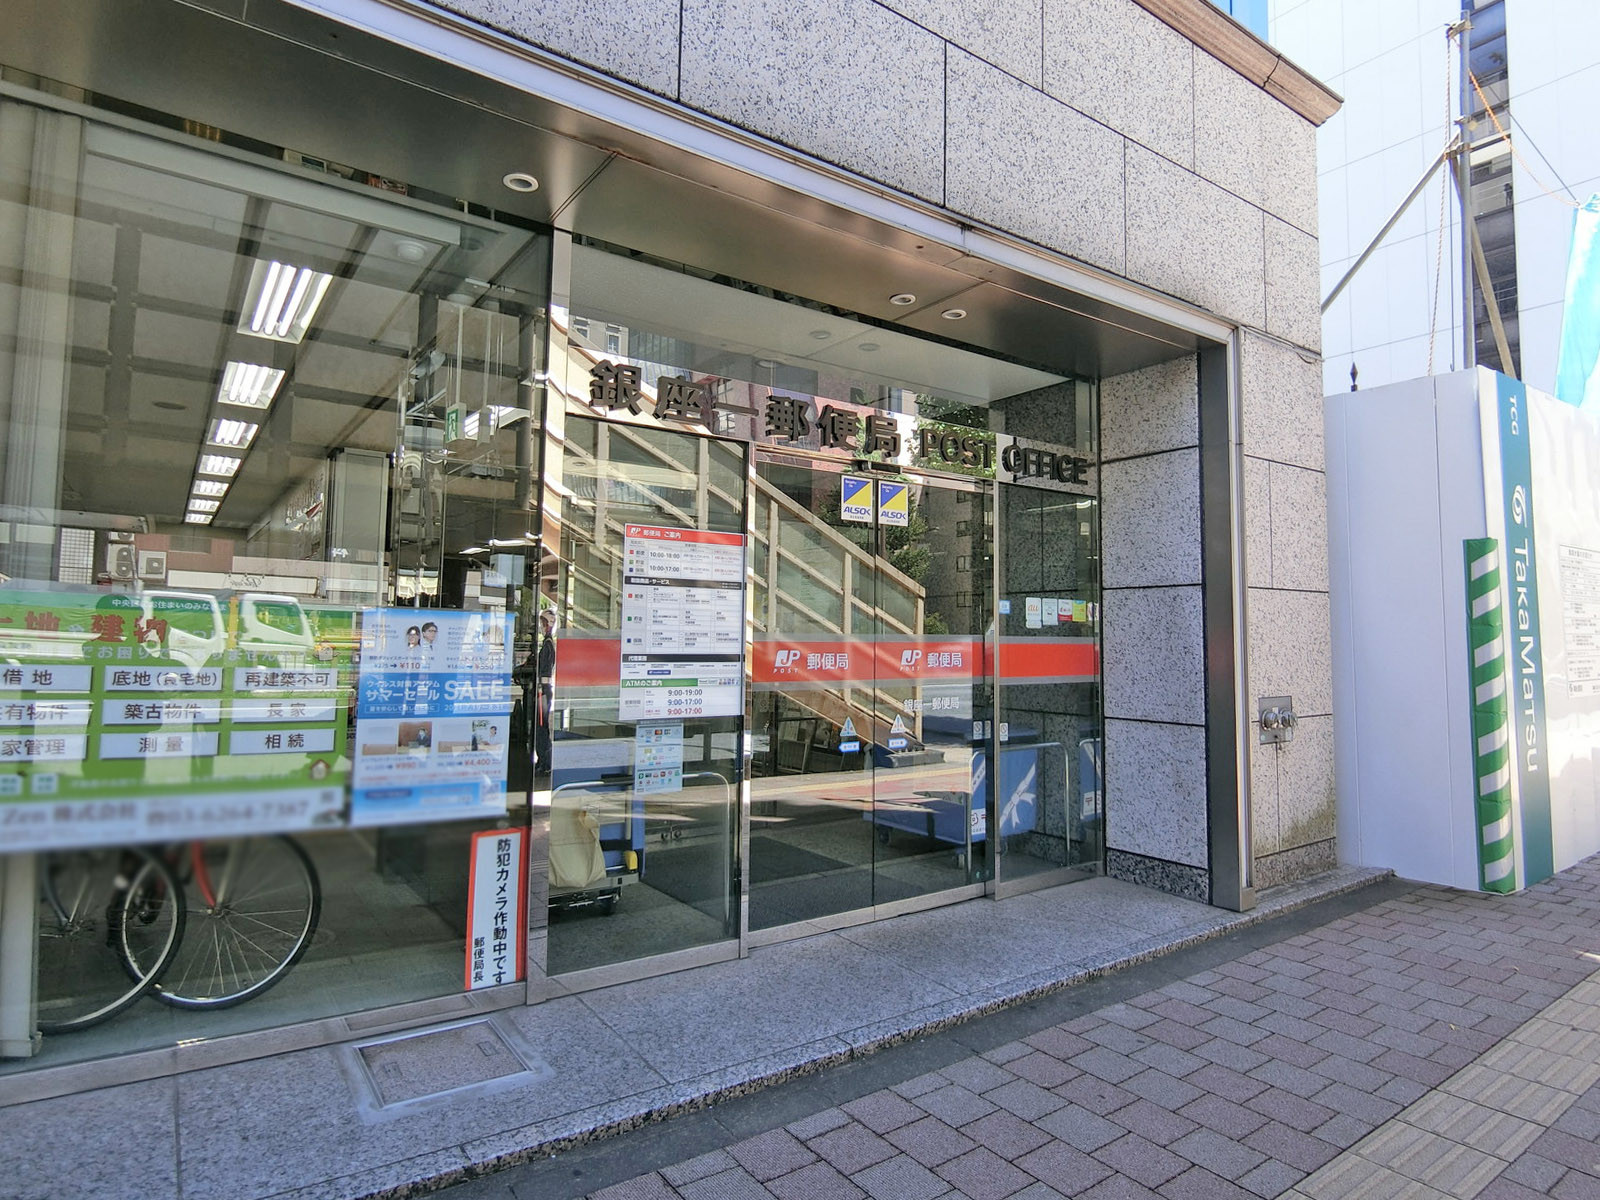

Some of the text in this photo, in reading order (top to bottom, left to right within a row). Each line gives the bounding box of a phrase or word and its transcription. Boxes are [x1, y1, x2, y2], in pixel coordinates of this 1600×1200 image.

[589, 358, 1089, 485] 銀座一郵便局 POST OFFICE
[1509, 394, 1520, 436] TCG
[843, 506, 871, 516] ALSOK
[880, 511, 906, 520] ALSOK
[650, 551, 680, 560] 10:00-18:00
[649, 564, 680, 573] 10:00-17:00
[807, 653, 849, 670] 郵便局
[927, 652, 962, 668] 郵便局
[3, 668, 53, 686] 借地
[245, 671, 330, 687] 再建築不可
[366, 689, 440, 701] サマーセール
[444, 680, 504, 700] SALE
[268, 702, 306, 718] 長家
[667, 698, 703, 706] 9:00-17:00
[904, 697, 961, 713] 銀座一郵便局
[0, 703, 69, 720] 有物件
[124, 703, 201, 720] 築古物件
[667, 707, 702, 715] 9:00-17:00
[138, 736, 184, 754] 測量
[265, 733, 305, 749] 相続
[492, 837, 511, 985] 防犯カメラ作動中です
[473, 936, 485, 982] 郵便局長
